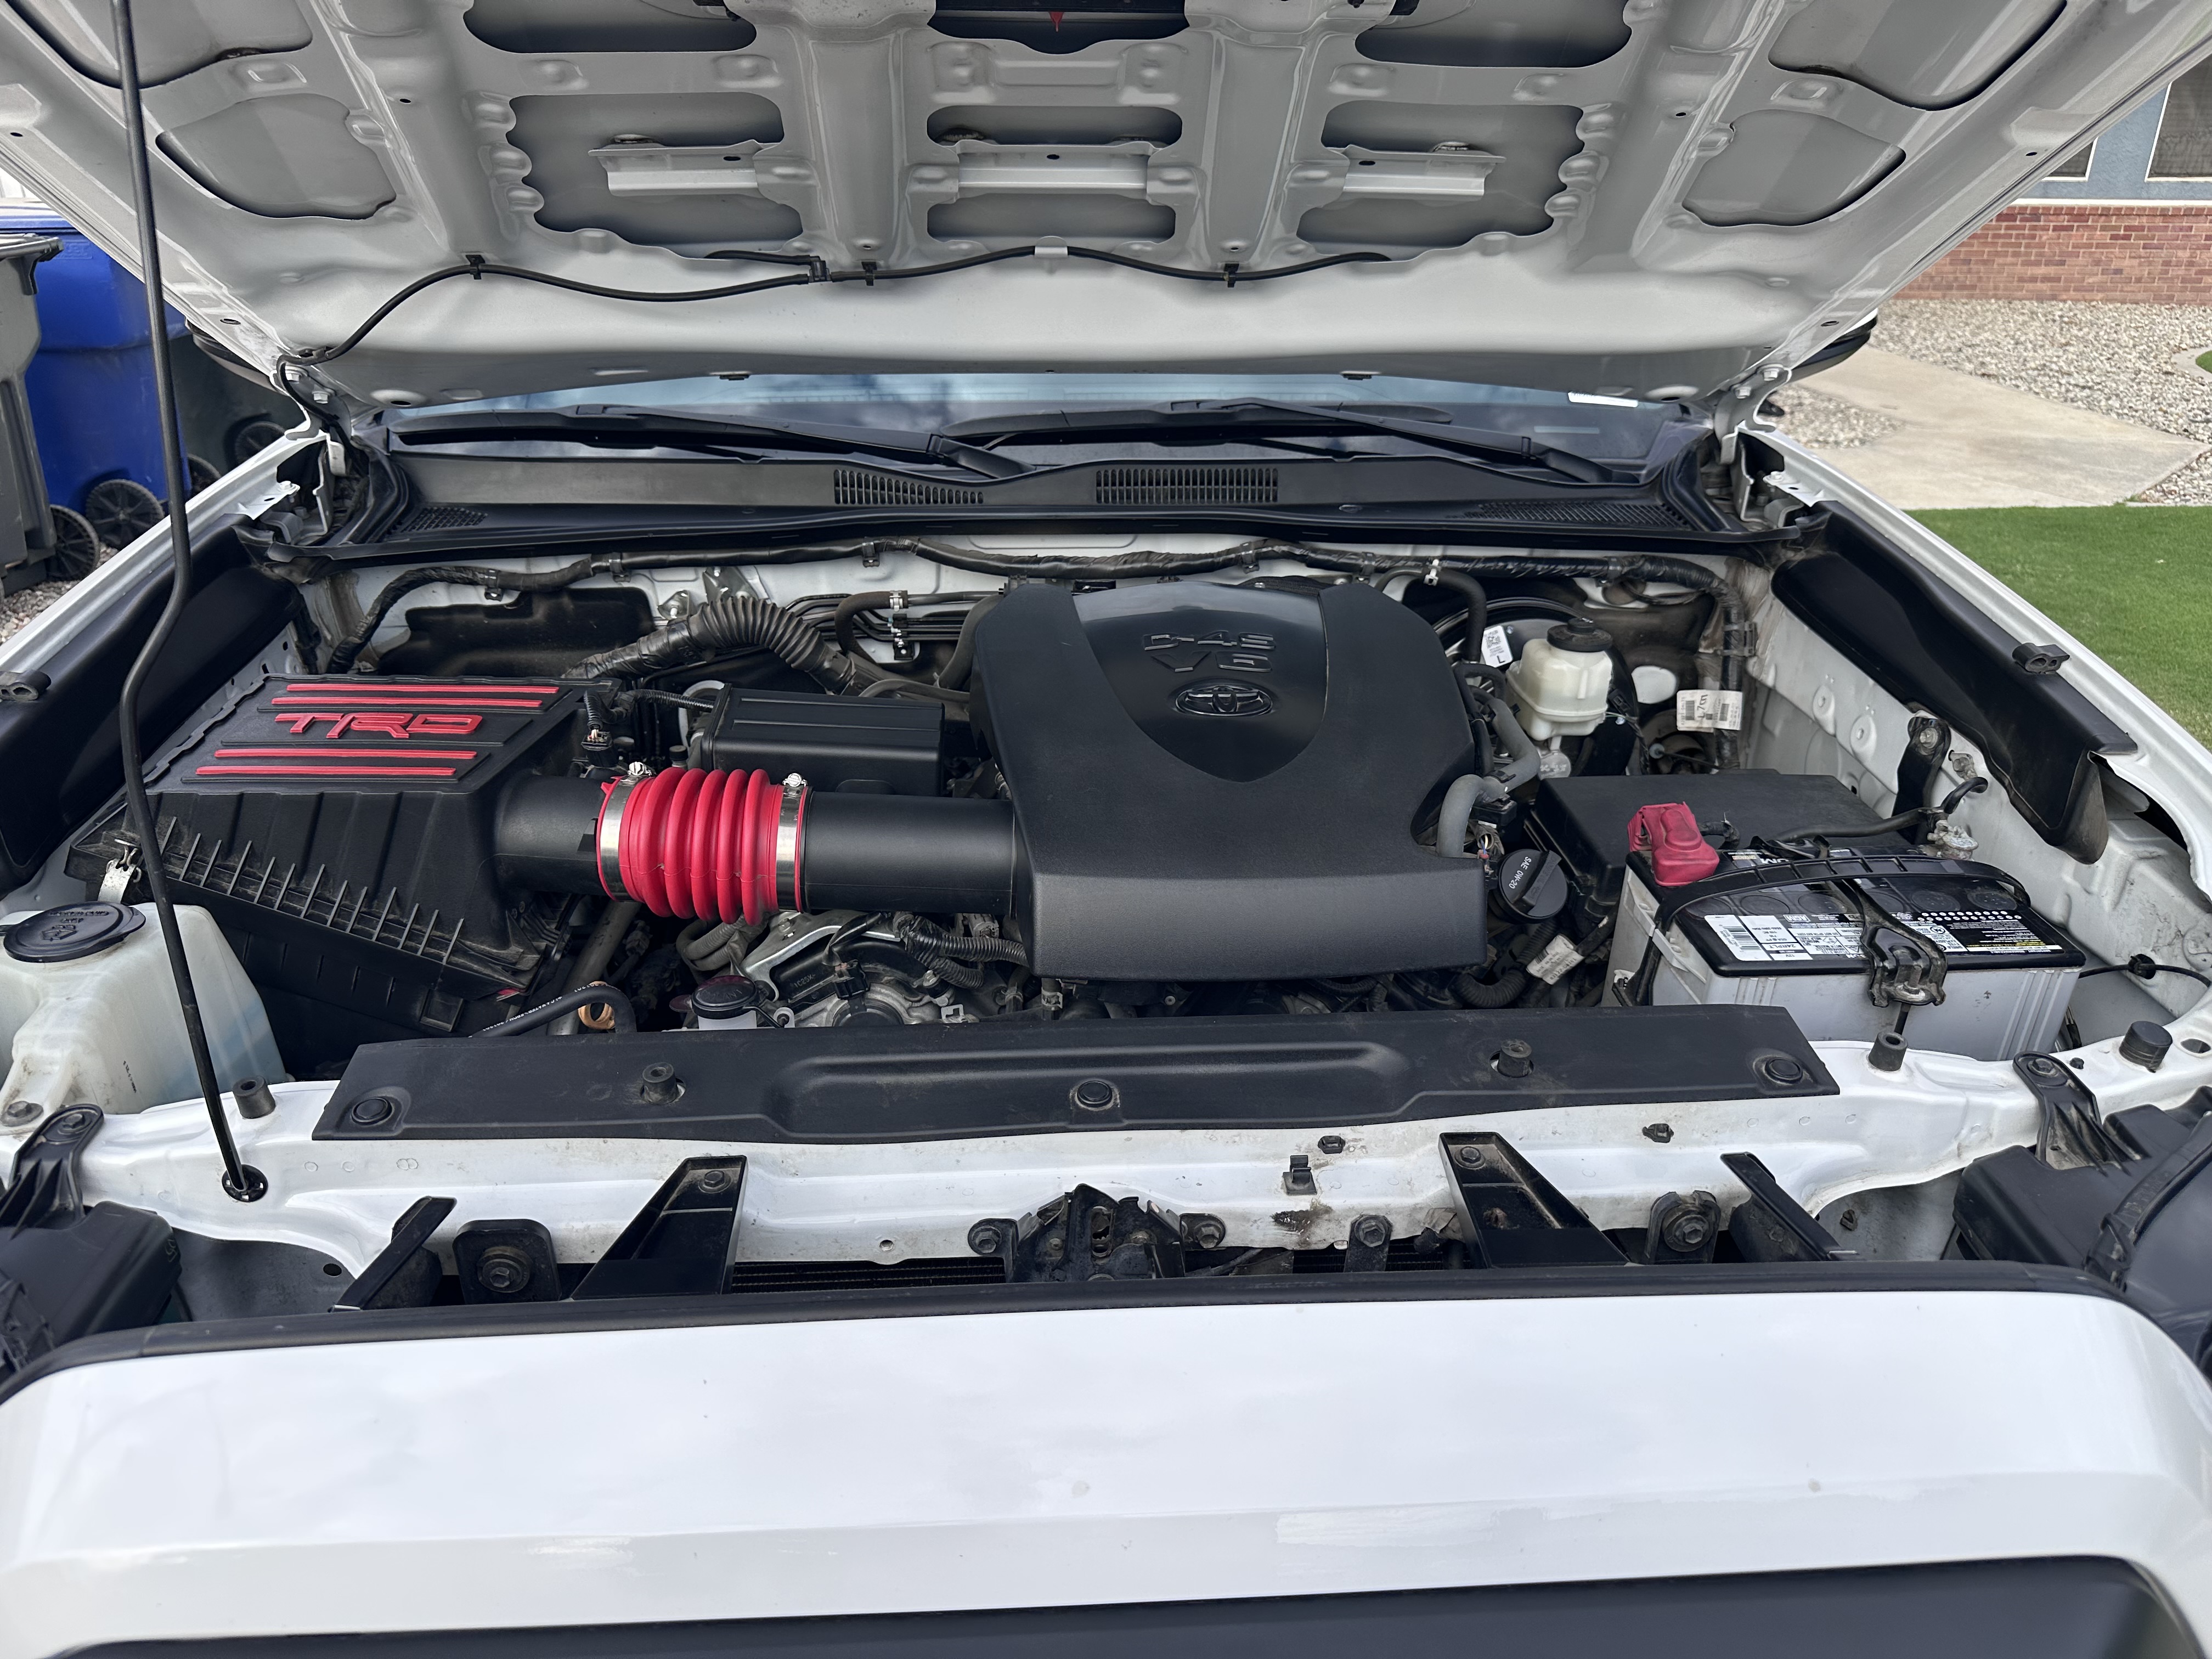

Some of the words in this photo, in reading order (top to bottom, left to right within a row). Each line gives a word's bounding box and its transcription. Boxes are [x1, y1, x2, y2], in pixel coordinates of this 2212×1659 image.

[1143, 630, 1276, 652] D-4S
[1150, 651, 1273, 673] V6
[274, 712, 483, 739] TRD
[1520, 856, 1532, 870] SAE
[1508, 870, 1524, 889] 0W-20
